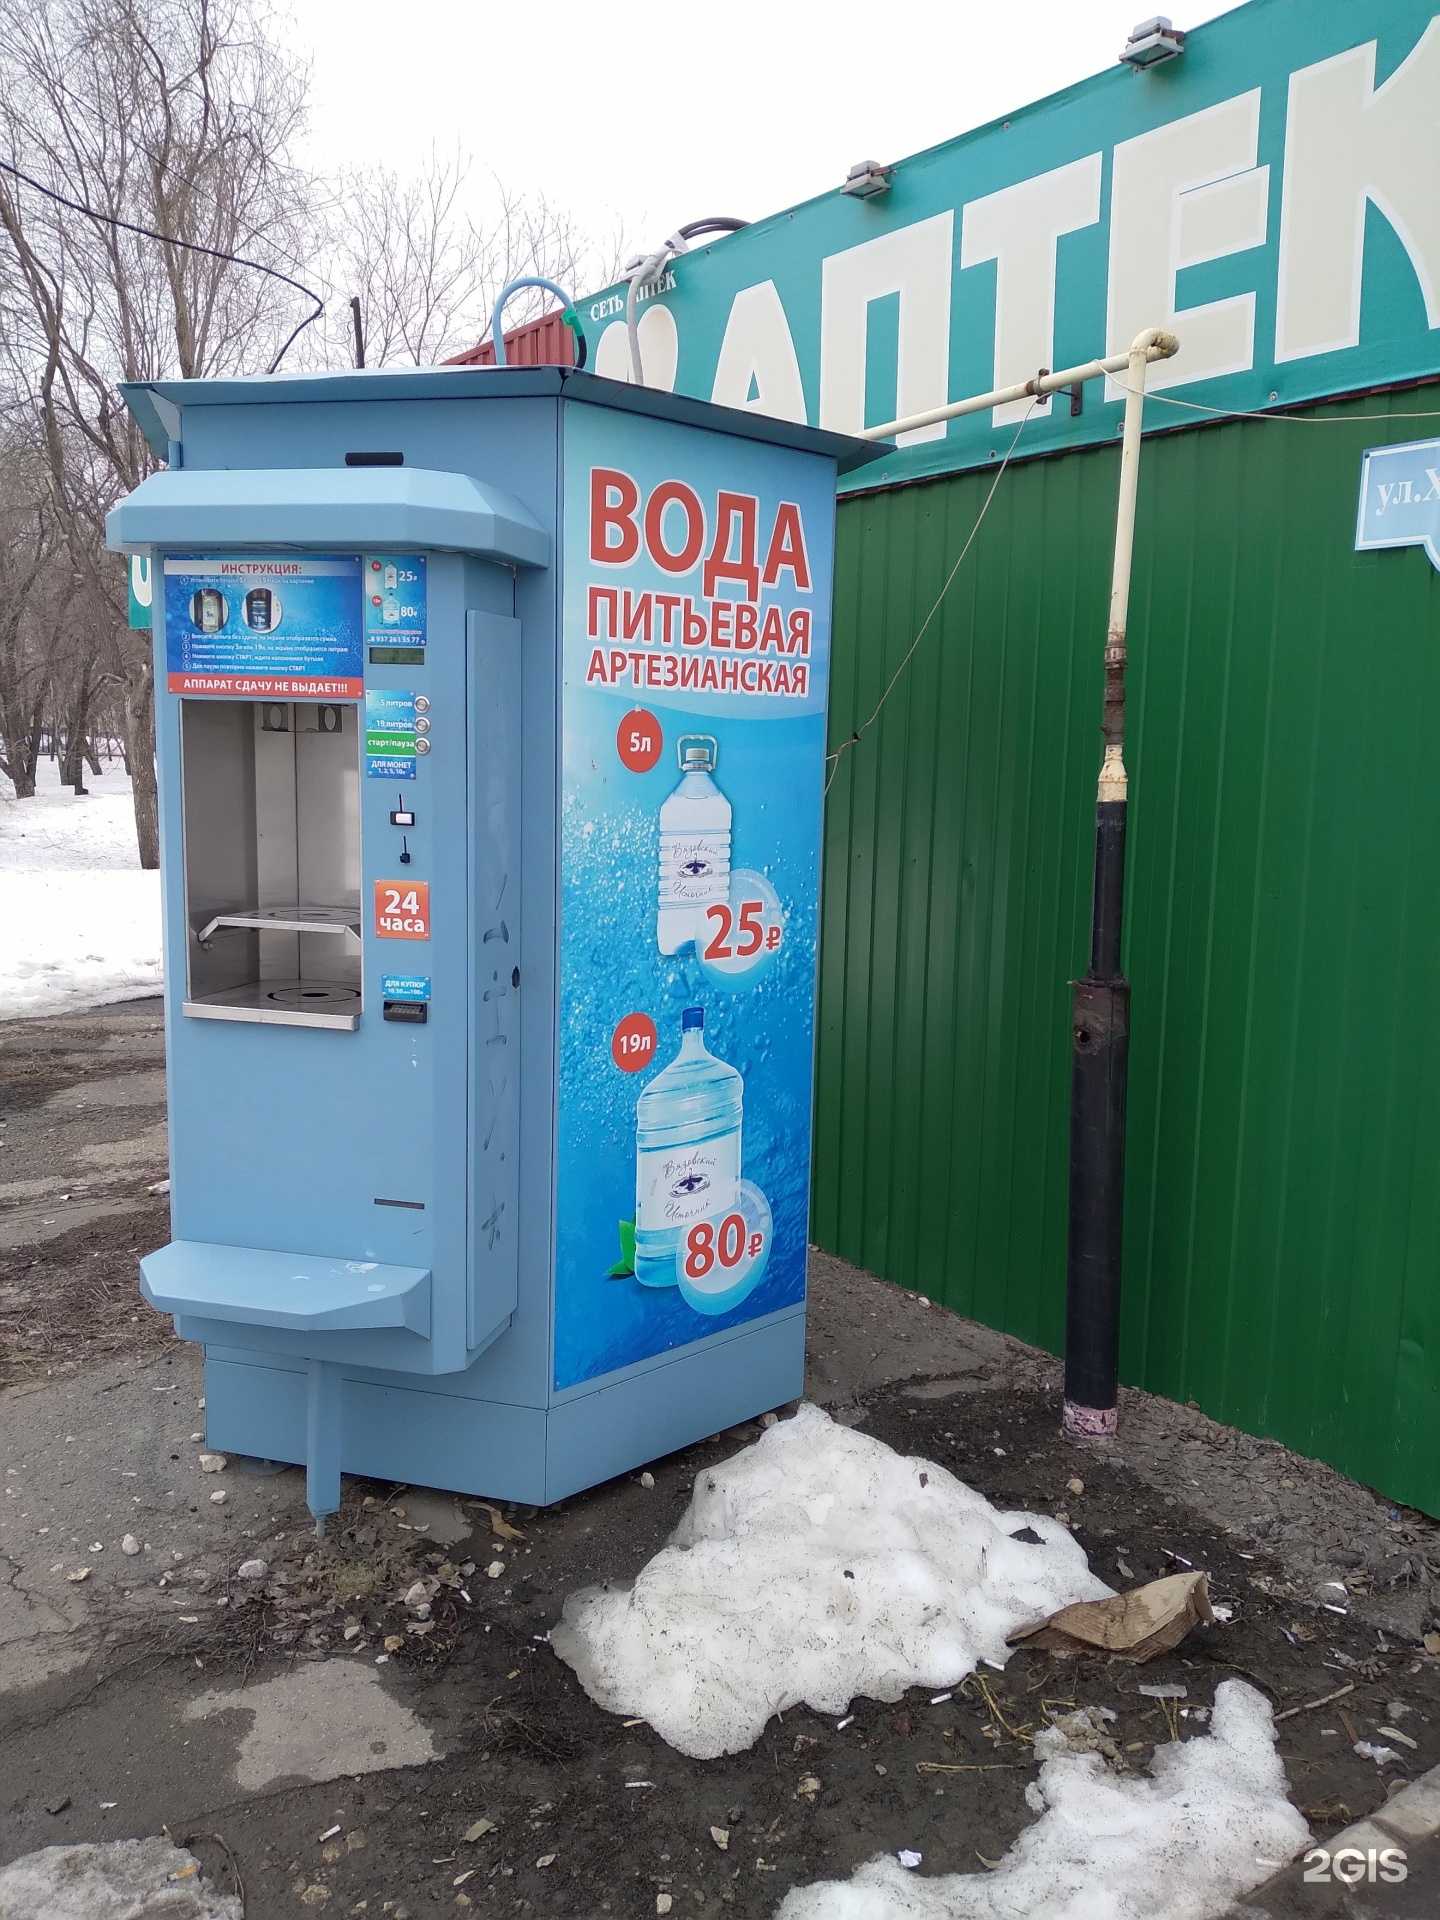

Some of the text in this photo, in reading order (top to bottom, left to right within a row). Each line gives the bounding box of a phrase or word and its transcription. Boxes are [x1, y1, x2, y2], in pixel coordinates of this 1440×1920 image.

[590, 295, 624, 322] СЕТЬ
[589, 467, 813, 602] ВОДА
[221, 564, 303, 576] ИНСТРУКЦИЯ:
[587, 585, 811, 659] ПИТЬЕВАЯ
[586, 649, 810, 697] АРТЕЗИАНСКАЯ
[183, 678, 348, 693] АППАРАТ СДАЧУ НЕ ВЫДАЕТ!!!
[367, 739, 415, 748] старт/пауза
[630, 732, 651, 752] 5л
[384, 889, 420, 915] 24
[379, 917, 425, 933] часа
[620, 1033, 651, 1055] 19л
